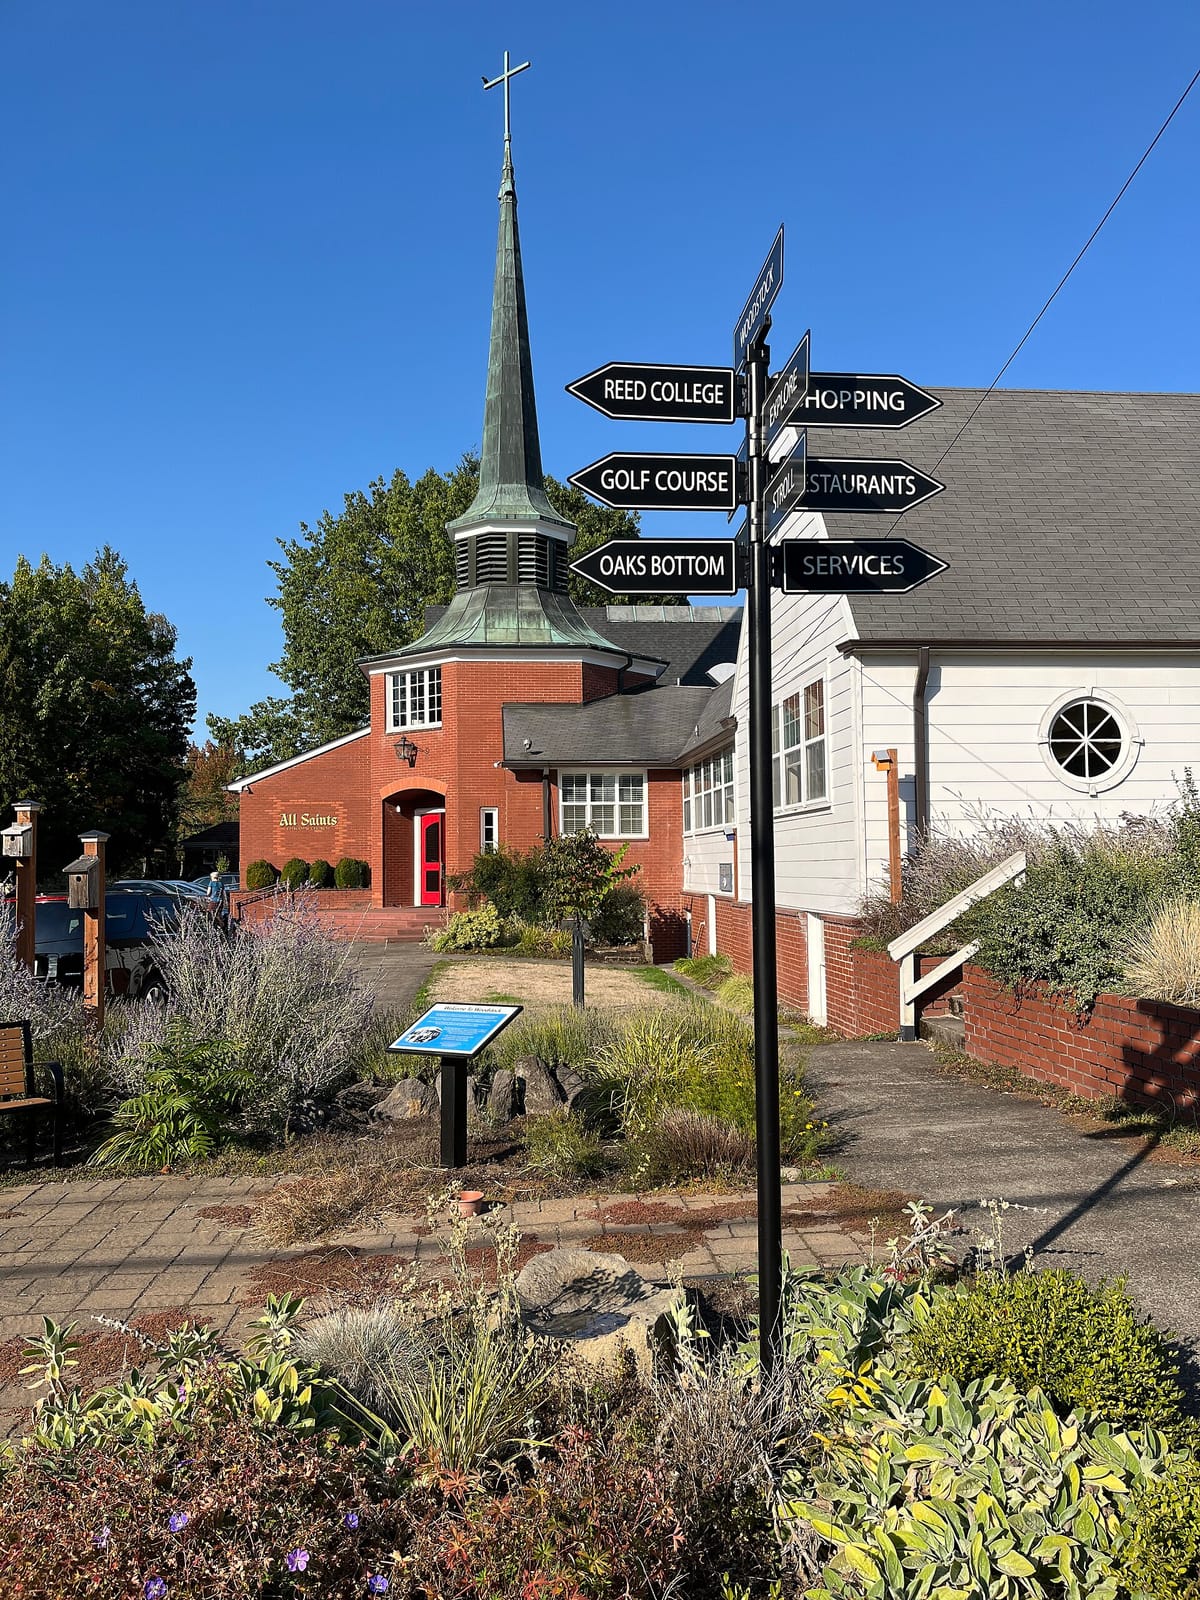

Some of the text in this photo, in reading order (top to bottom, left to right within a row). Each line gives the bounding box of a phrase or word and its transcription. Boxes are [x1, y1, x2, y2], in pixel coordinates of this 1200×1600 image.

[740, 262, 774, 348] WOODSTOCK
[604, 378, 724, 405] REED COLLEGE
[769, 366, 798, 428] EXPLORE
[799, 389, 906, 411] HOPPING
[600, 469, 729, 493] GOLF COURSE
[772, 467, 795, 514] STROLL
[804, 472, 917, 496] STAURANTS
[600, 555, 725, 576] OAKS BOTTOM
[803, 555, 905, 575] SERVICES
[279, 813, 338, 826] All Saints
